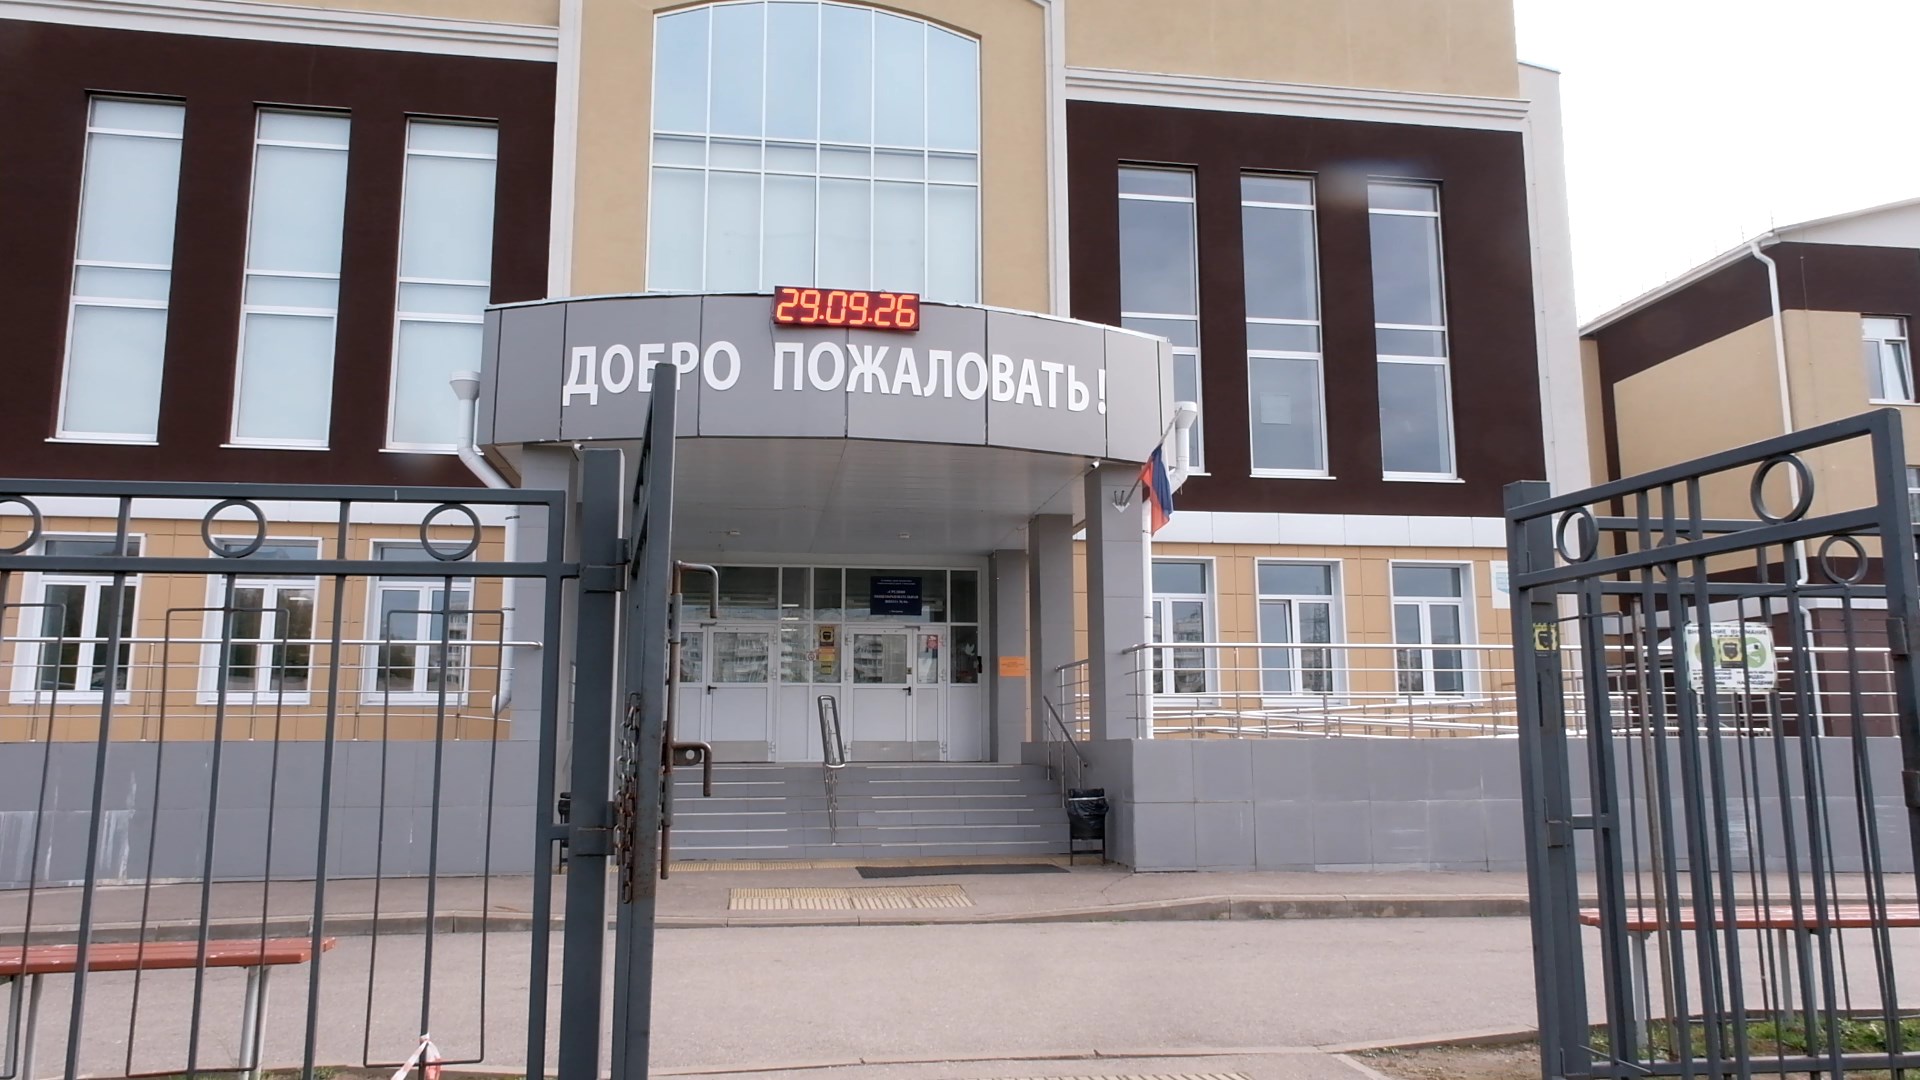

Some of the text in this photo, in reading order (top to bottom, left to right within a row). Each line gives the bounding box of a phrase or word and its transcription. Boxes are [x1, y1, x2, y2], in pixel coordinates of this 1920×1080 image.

[777, 288, 916, 327] 29.09.26
[562, 341, 1107, 414] ДОБРО ПОЖАЛОВАТЬ!
